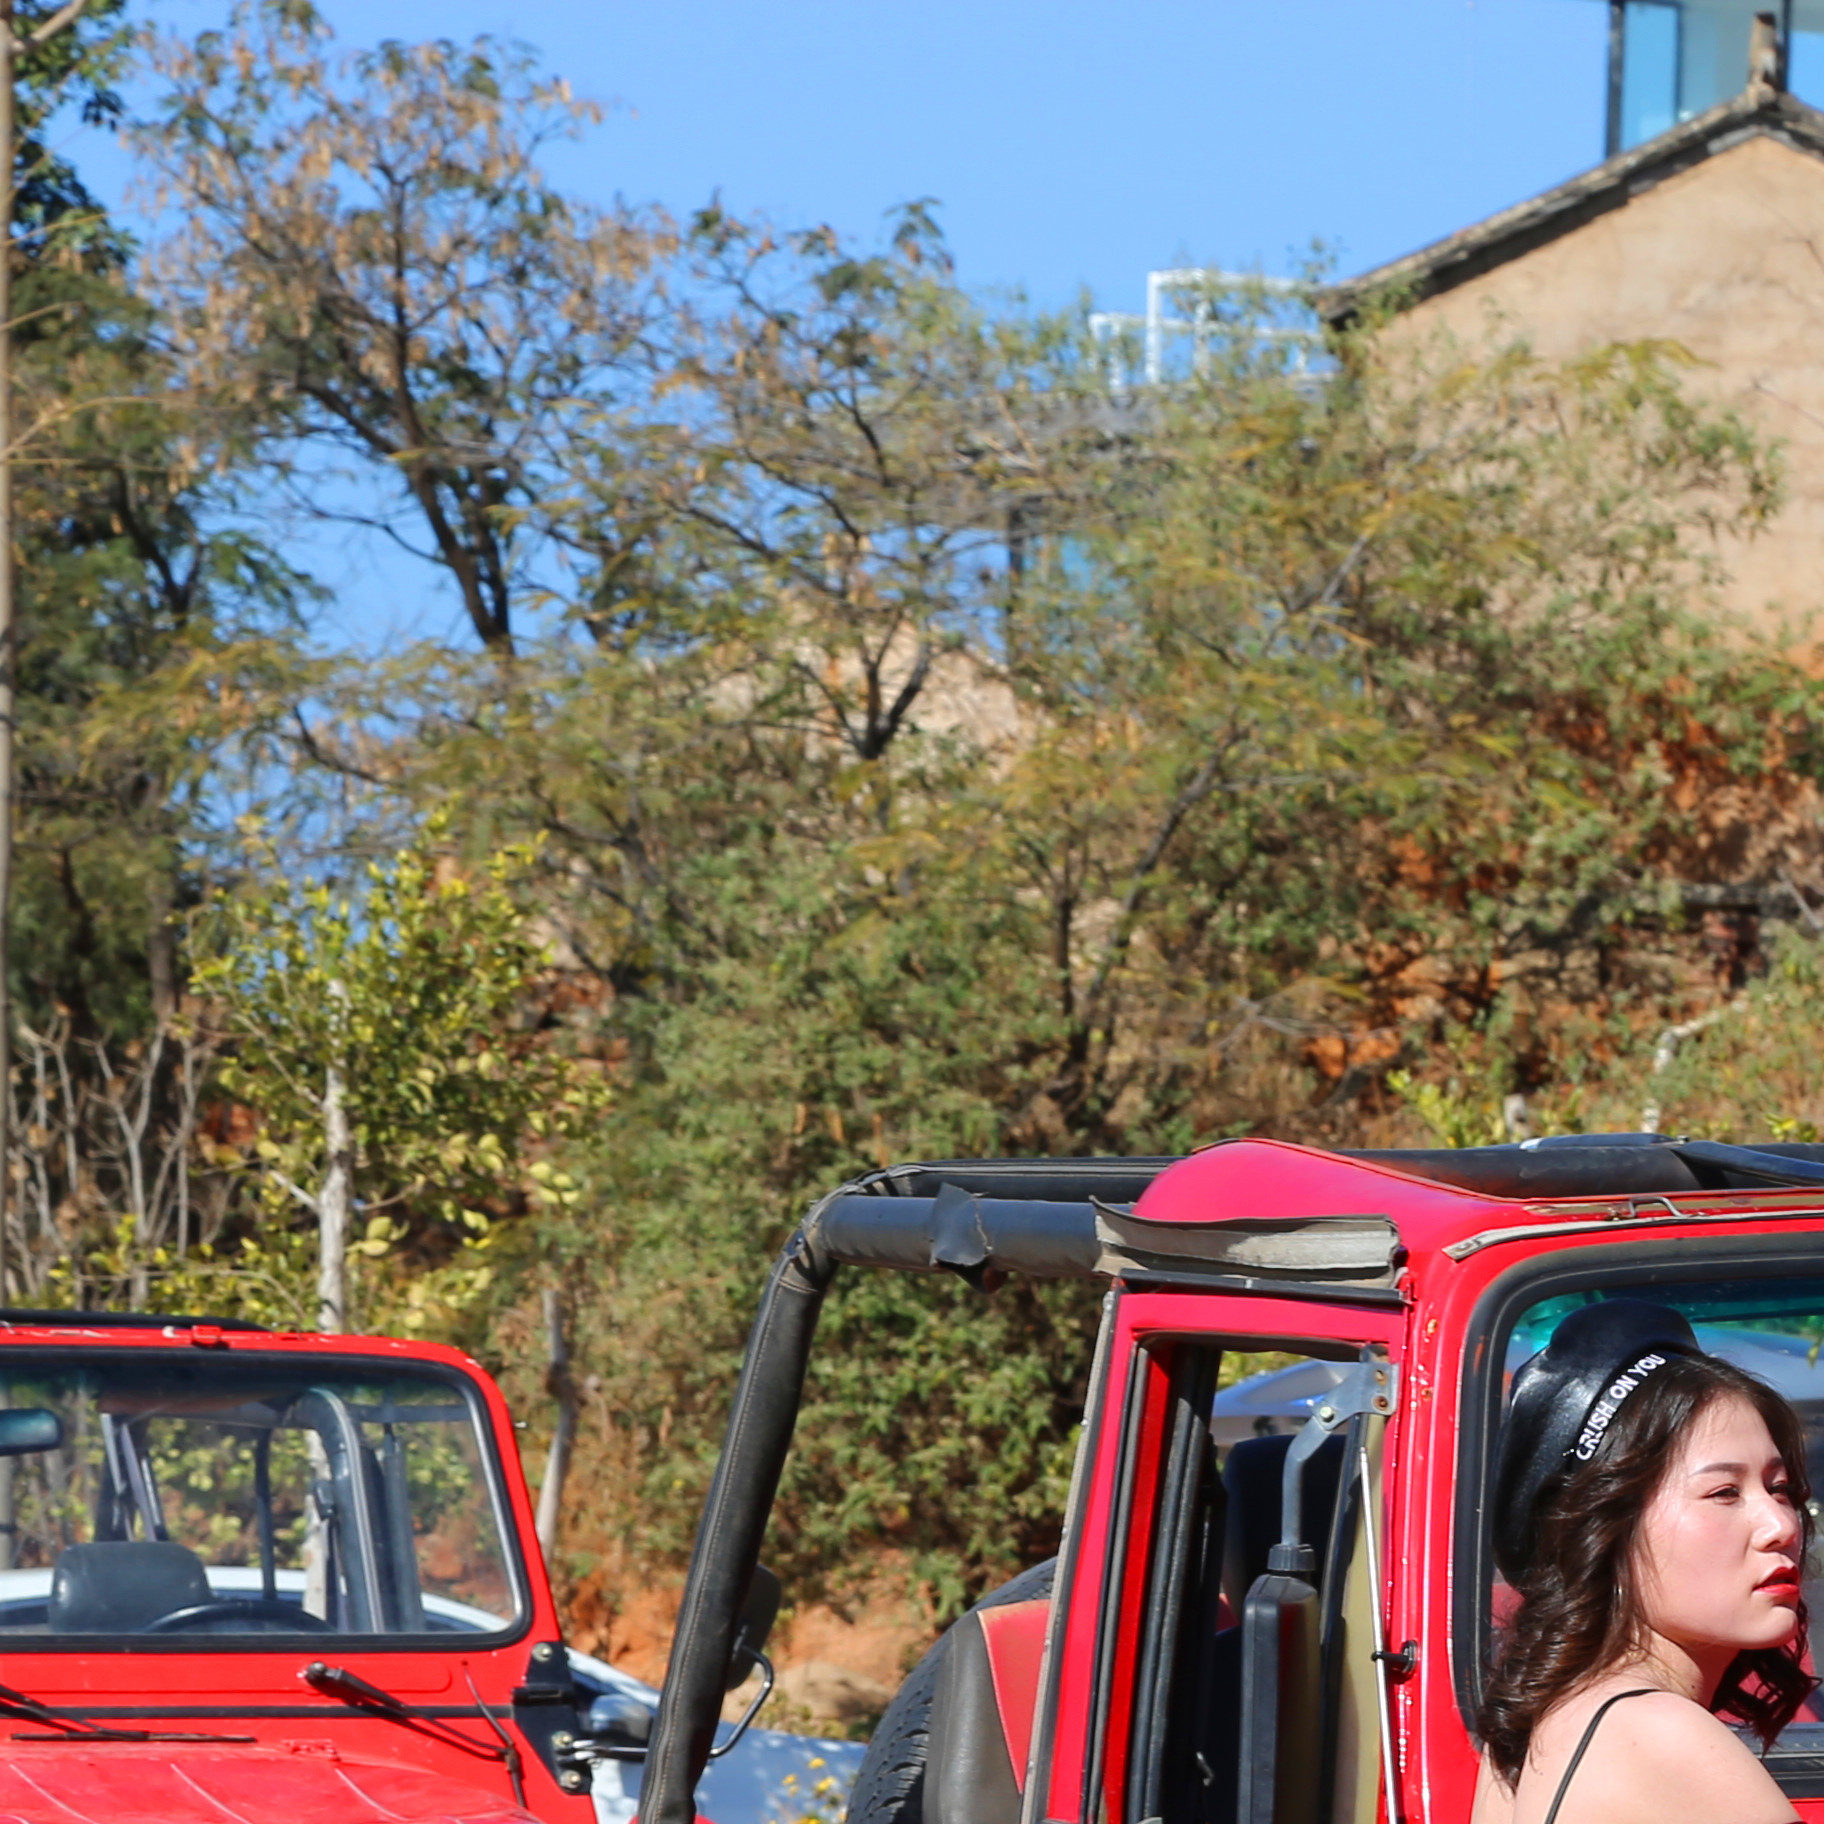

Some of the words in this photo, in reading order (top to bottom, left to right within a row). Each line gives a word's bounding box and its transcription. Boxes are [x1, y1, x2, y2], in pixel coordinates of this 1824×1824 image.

[1576, 1400, 1617, 1460] CRUSH
[1609, 1374, 1639, 1399] ON
[1627, 1354, 1666, 1377] YOU
